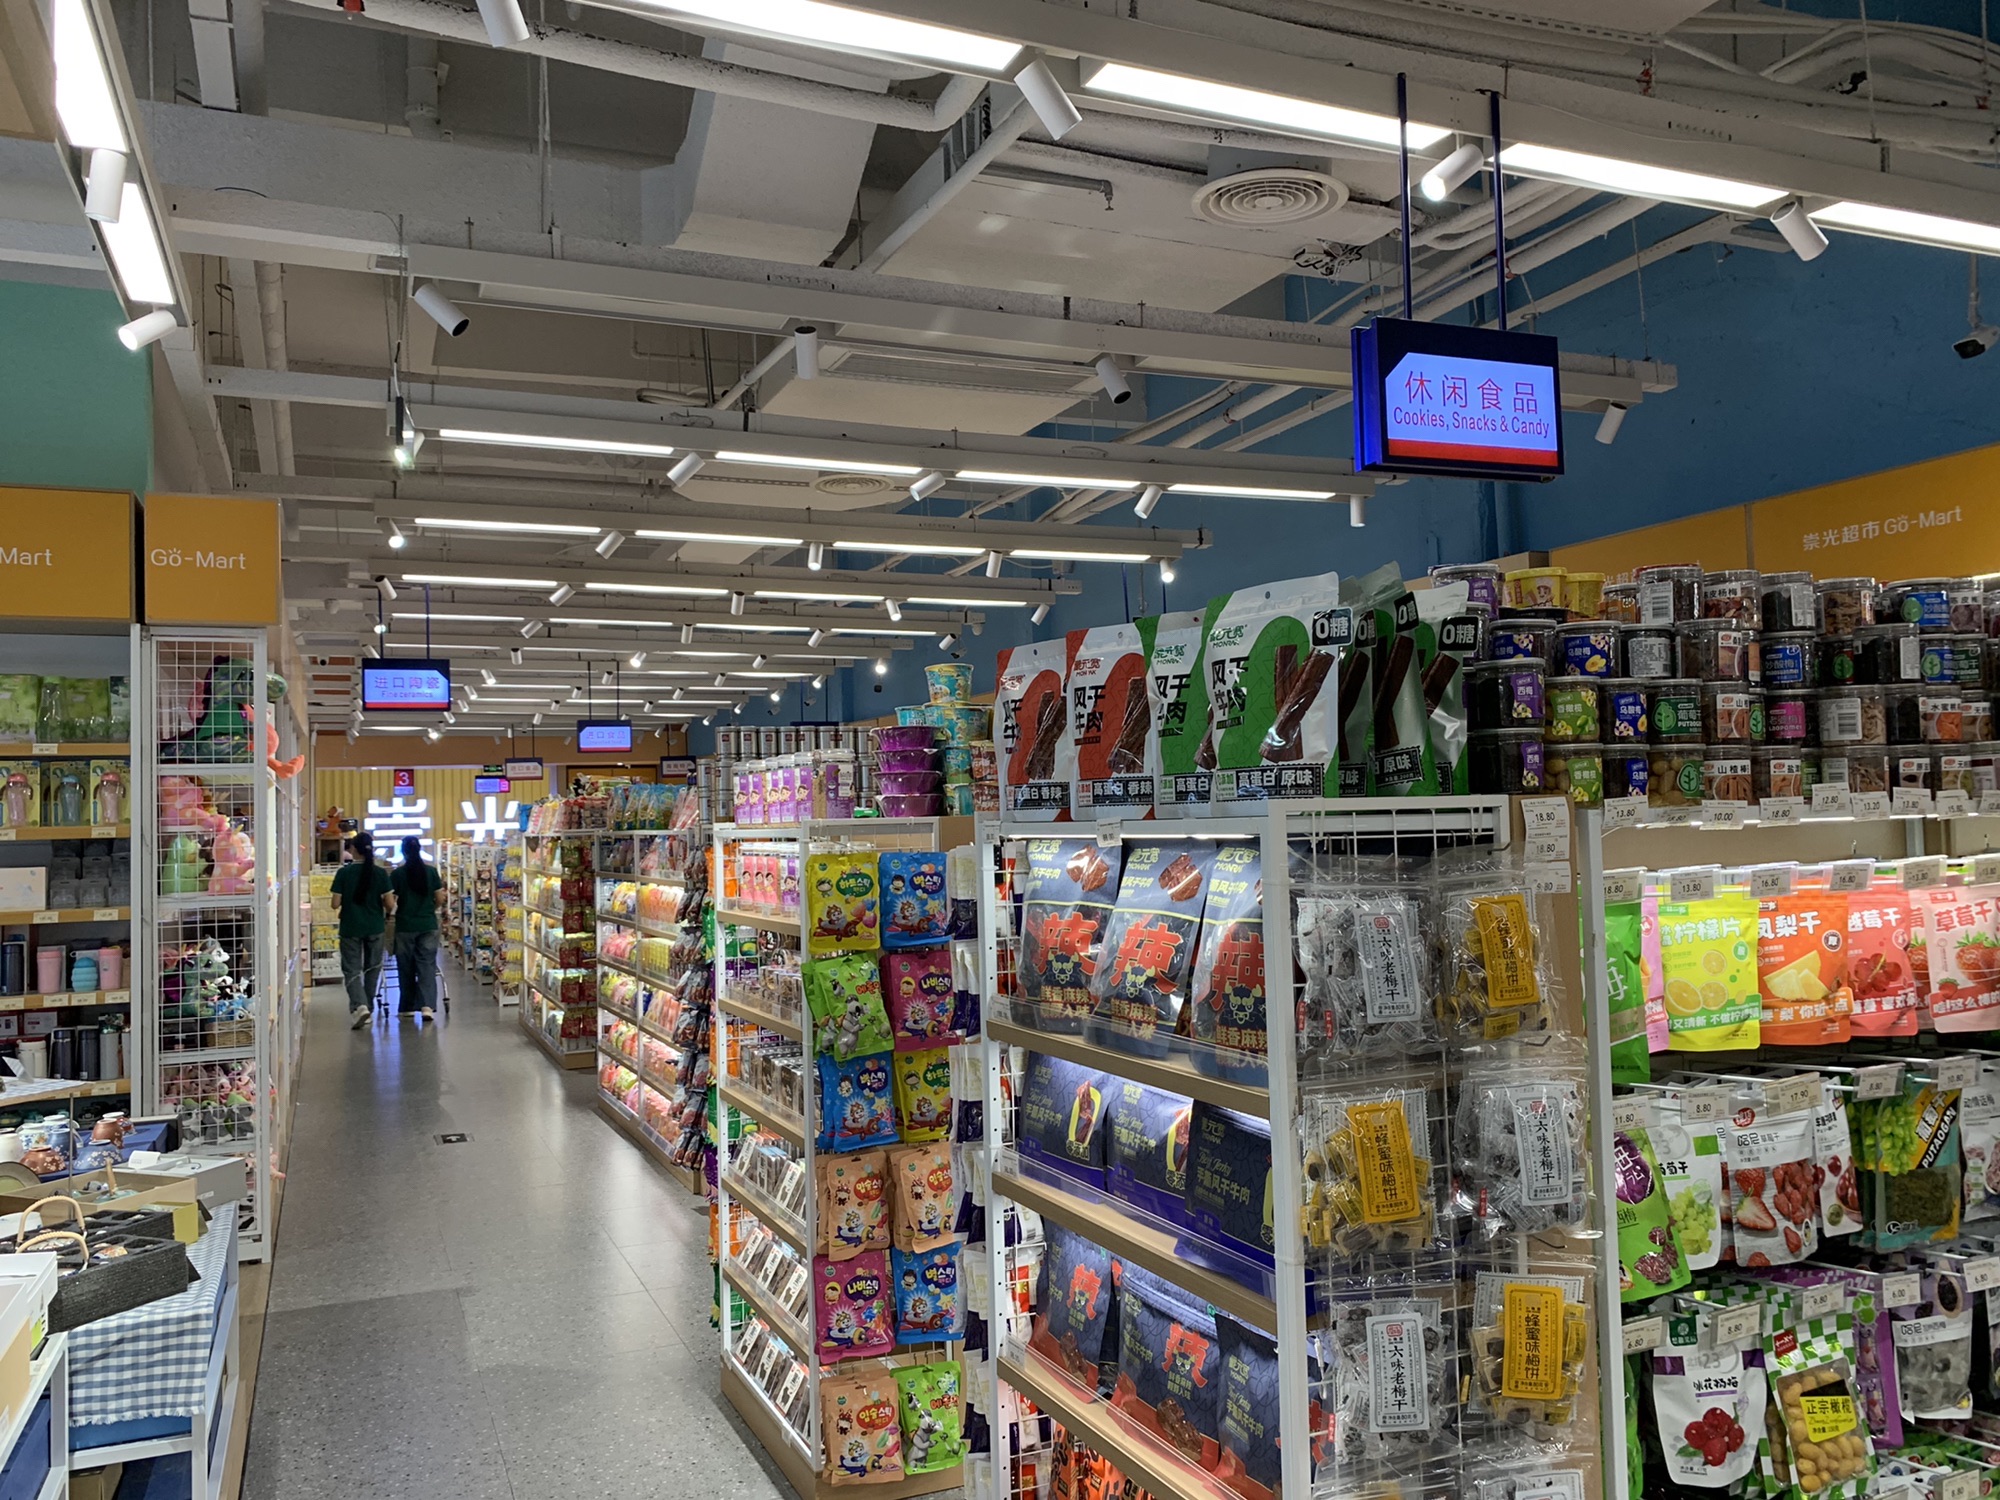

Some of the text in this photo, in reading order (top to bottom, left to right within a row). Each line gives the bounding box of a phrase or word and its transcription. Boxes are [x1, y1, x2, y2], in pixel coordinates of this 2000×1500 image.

[1405, 370, 1538, 414] 休闲食品
[1394, 406, 1549, 438] Cookies, Snacks & Candy
[1802, 521, 1881, 552] 崇光超市
[1211, 656, 1249, 688] 风干
[374, 676, 440, 689] 进口陶瓷
[1155, 674, 1191, 699] 风干
[382, 690, 434, 698] Fine ceramics
[1074, 684, 1106, 711] 风干
[1517, 686, 1533, 696] 西梅
[1074, 711, 1104, 734] 牛肉
[1384, 754, 1412, 772] 原味
[1526, 754, 1540, 764] 西梅
[399, 772, 409, 786] 3
[1176, 776, 1210, 792] 高蛋白
[1238, 770, 1276, 787] 高蛋白
[1281, 769, 1313, 785] 原味
[1041, 787, 1062, 799] 香辣
[1093, 781, 1123, 796] 高蛋白
[1127, 780, 1153, 794] 香辣
[1822, 794, 1839, 805] 12.80
[1863, 801, 1881, 811] 13.20
[1535, 812, 1556, 822] 18.80
[1616, 808, 1636, 818] 13.80
[1713, 812, 1733, 821] 10.00
[1771, 809, 1790, 819] 18.80
[1536, 843, 1556, 854] 18.80
[1761, 878, 1779, 888] 16.80
[1839, 875, 1856, 885] 16.80
[1603, 885, 1624, 895] 18.80
[1682, 883, 1702, 893] 13.80
[1934, 900, 1994, 933] 草莓干
[1674, 917, 1741, 944] 柠檬片
[1109, 921, 1183, 995] 辣
[1378, 936, 1400, 1001] 六味老梅干
[1111, 998, 1158, 1021] 鲜香麻辣
[1790, 1089, 1809, 1101] 17.90
[1696, 1103, 1712, 1113] 8.80
[1615, 1113, 1635, 1125] 11.80
[1922, 1107, 1958, 1169] PUTAOGAN
[1534, 1120, 1554, 1185] 六味老梅干
[1375, 1132, 1398, 1199] 蜂蜜味梅饼
[925, 1267, 955, 1280] 별스틱
[847, 1279, 879, 1294] 나비스틱
[1892, 1288, 1906, 1299] 6.00
[1813, 1294, 1828, 1306] 9.80
[1727, 1323, 1743, 1334] 8.80
[1523, 1314, 1540, 1380] 蜂蜜味梅饼
[1627, 1338, 1644, 1350] 6.80
[1388, 1345, 1409, 1412] 六味老梅干
[1806, 1399, 1852, 1415] 正宗橄榄
[858, 1406, 892, 1423] 입술스틱
